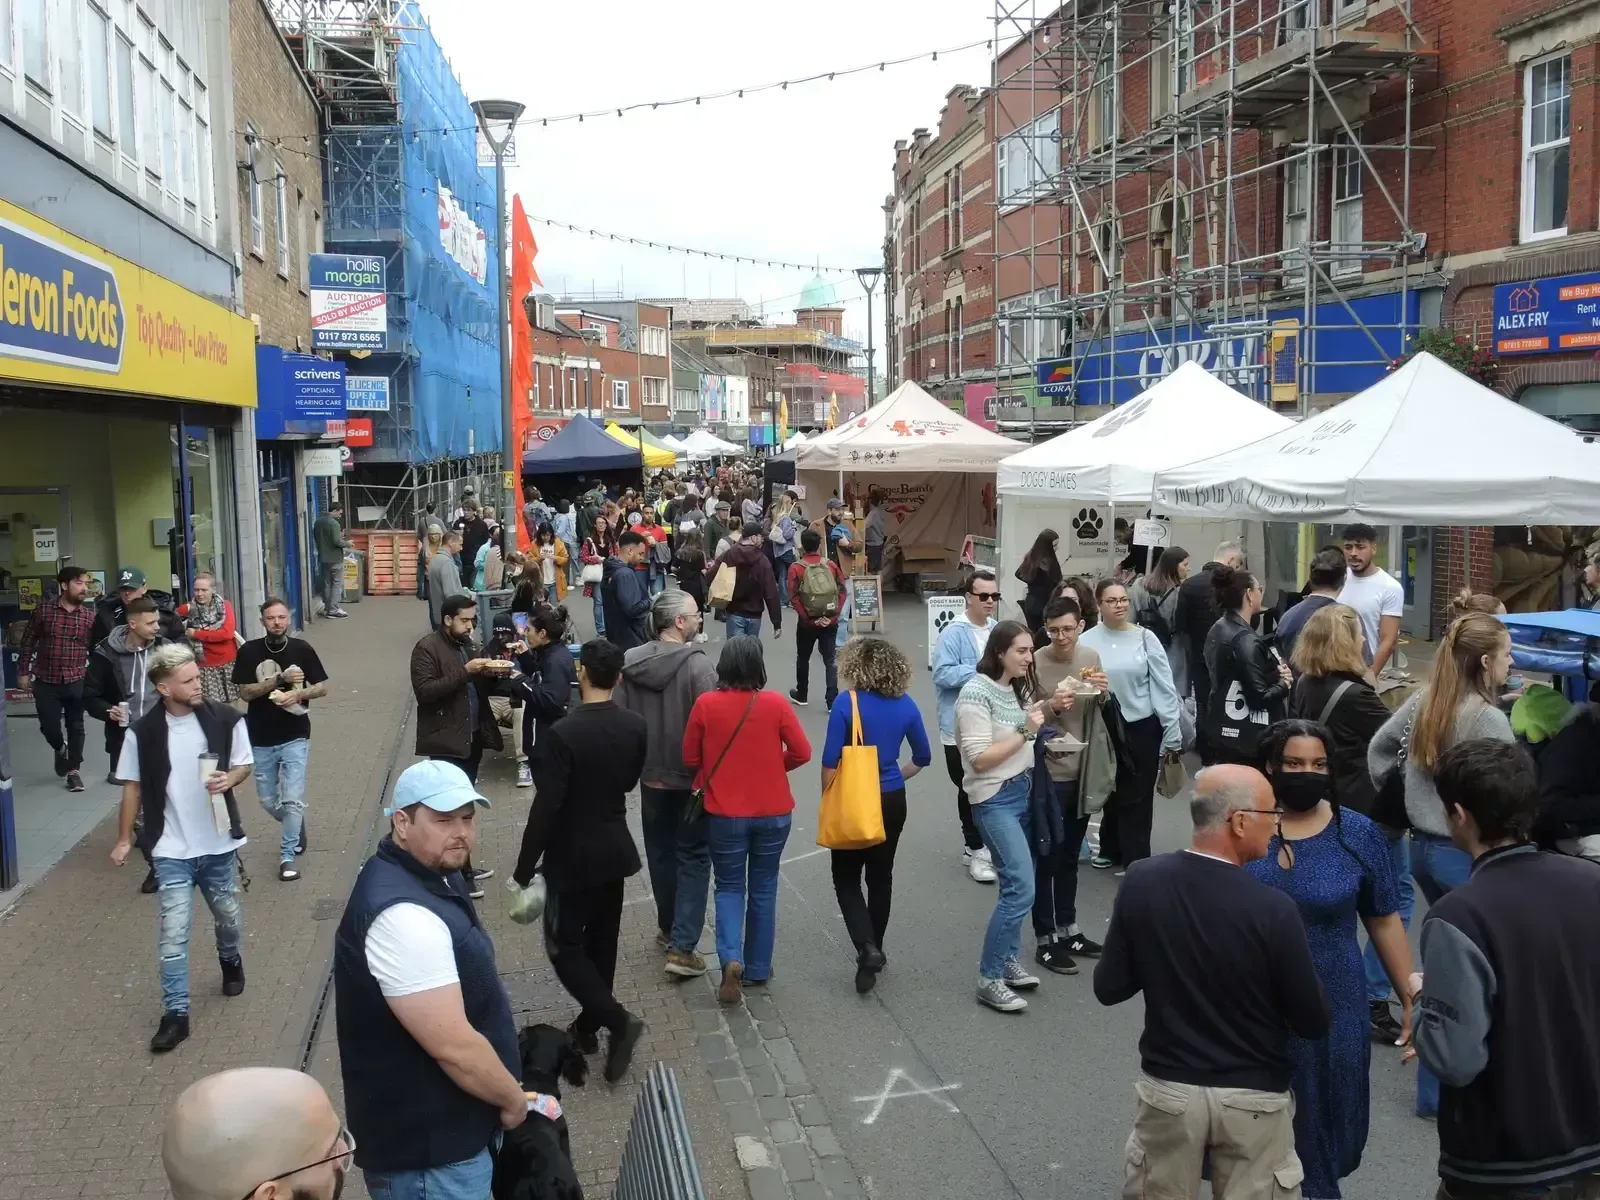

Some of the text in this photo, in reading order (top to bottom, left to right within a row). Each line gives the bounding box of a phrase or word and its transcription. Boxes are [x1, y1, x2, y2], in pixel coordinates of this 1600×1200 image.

[346, 257, 380, 272] hollis
[325, 271, 380, 286] morgan
[1575, 287, 1590, 297] Buy
[62, 269, 118, 349] Foods
[316, 312, 337, 324] SOLD
[338, 308, 348, 317] BY
[350, 297, 382, 313] AUCTION
[1577, 303, 1597, 314] Rent
[1498, 311, 1549, 330] ALEX FRY
[136, 304, 155, 357] Top
[156, 311, 187, 364] Quality
[193, 324, 208, 359] Low
[208, 331, 228, 366] Prices
[318, 332, 381, 342] 0117 973 6565
[294, 368, 341, 380] scrivens
[1043, 384, 1077, 393] CORA
[350, 391, 377, 400] OPEN
[362, 400, 386, 409] LATE
[1020, 471, 1077, 490] DOGGY BAKES
[35, 540, 56, 548] OUT
